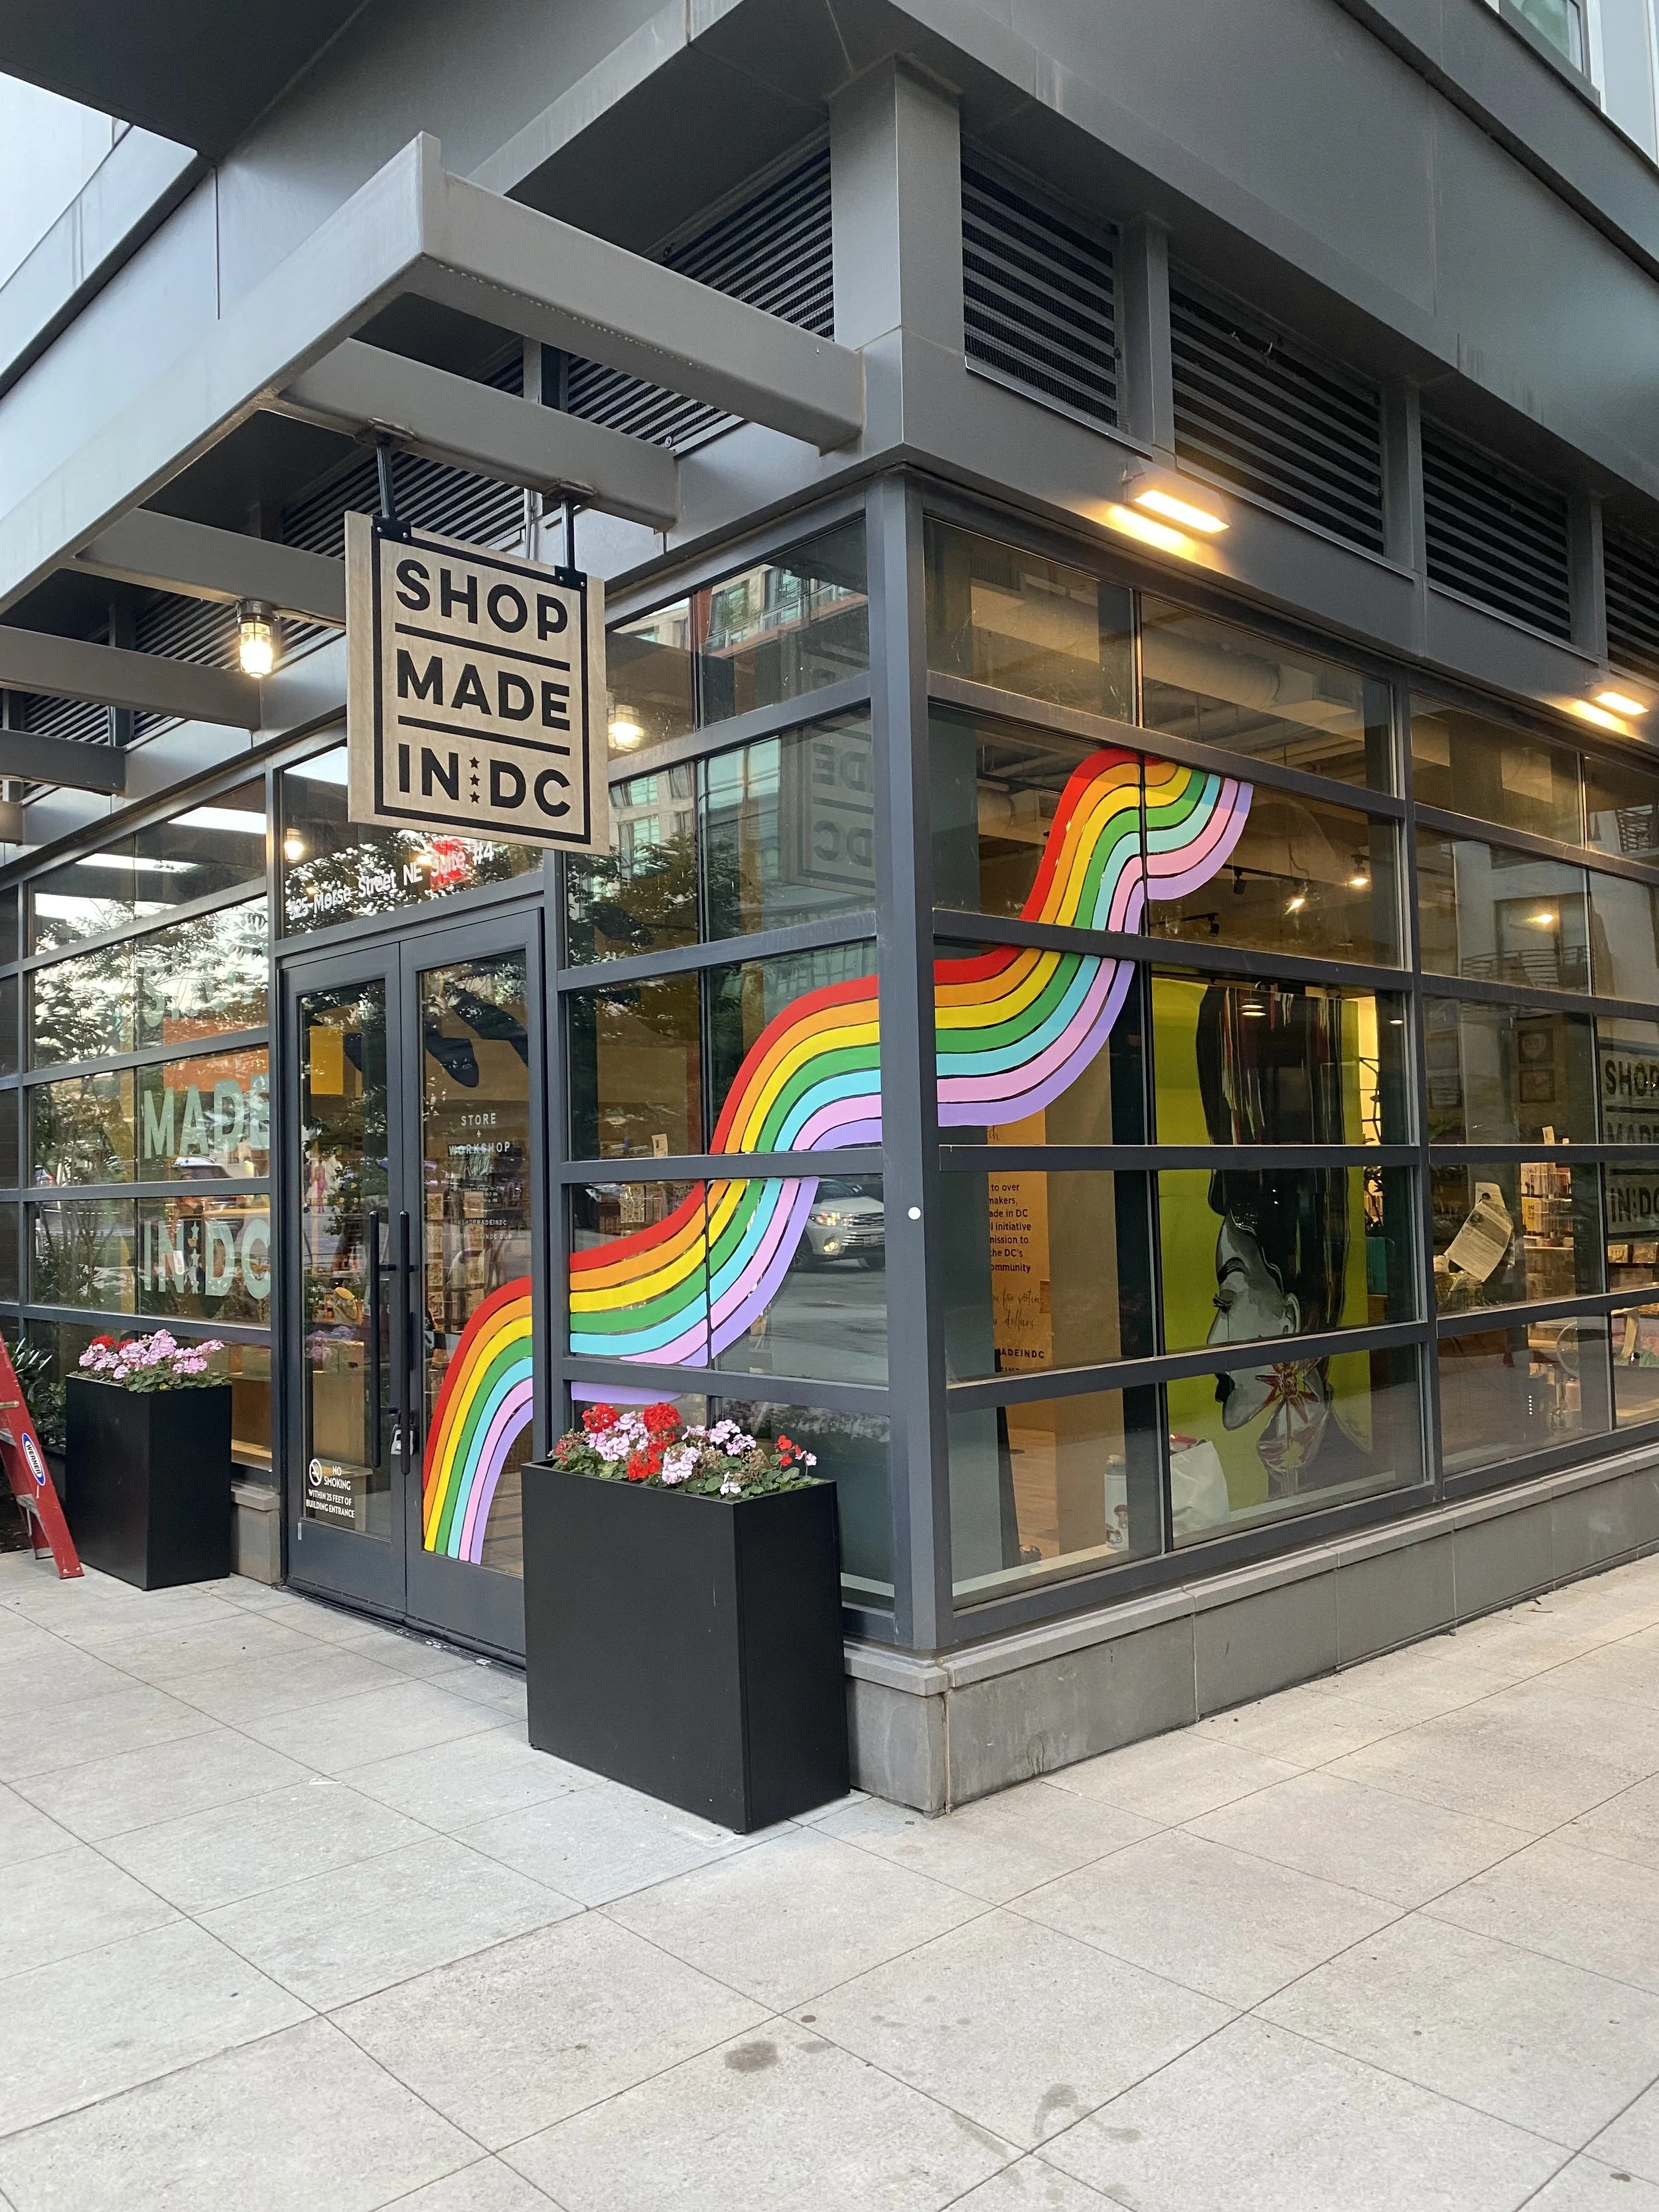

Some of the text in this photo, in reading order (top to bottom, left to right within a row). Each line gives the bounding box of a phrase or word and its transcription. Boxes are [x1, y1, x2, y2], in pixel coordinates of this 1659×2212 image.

[396, 559, 567, 641] SHOP
[397, 648, 570, 731] MADE
[398, 743, 571, 817] IN DC
[313, 885, 351, 914] Morse
[358, 869, 397, 898] Street
[403, 861, 423, 886] NE
[430, 850, 465, 877] Suite
[472, 840, 494, 866] #4
[1605, 1059, 1659, 1098] SHOP
[143, 1072, 269, 1159] MADE
[461, 1112, 496, 1127] STORE
[449, 1141, 510, 1155] WORKSHOP
[989, 1209, 1028, 1218] ade in DC
[995, 1222, 1031, 1230] initiative
[143, 1218, 271, 1300] IN DC
[1004, 1248, 1023, 1258] DC's
[991, 1263, 1031, 1274] ommunity
[1001, 1348, 1045, 1359] ADEINDC
[27, 1443, 41, 1475] WERNER
[332, 1466, 342, 1477] NO
[324, 1476, 350, 1491] SMOKING
[308, 1489, 352, 1506] WITHIN 25 FEET OF
[306, 1499, 355, 1518] BUILDING ENTRANCE
